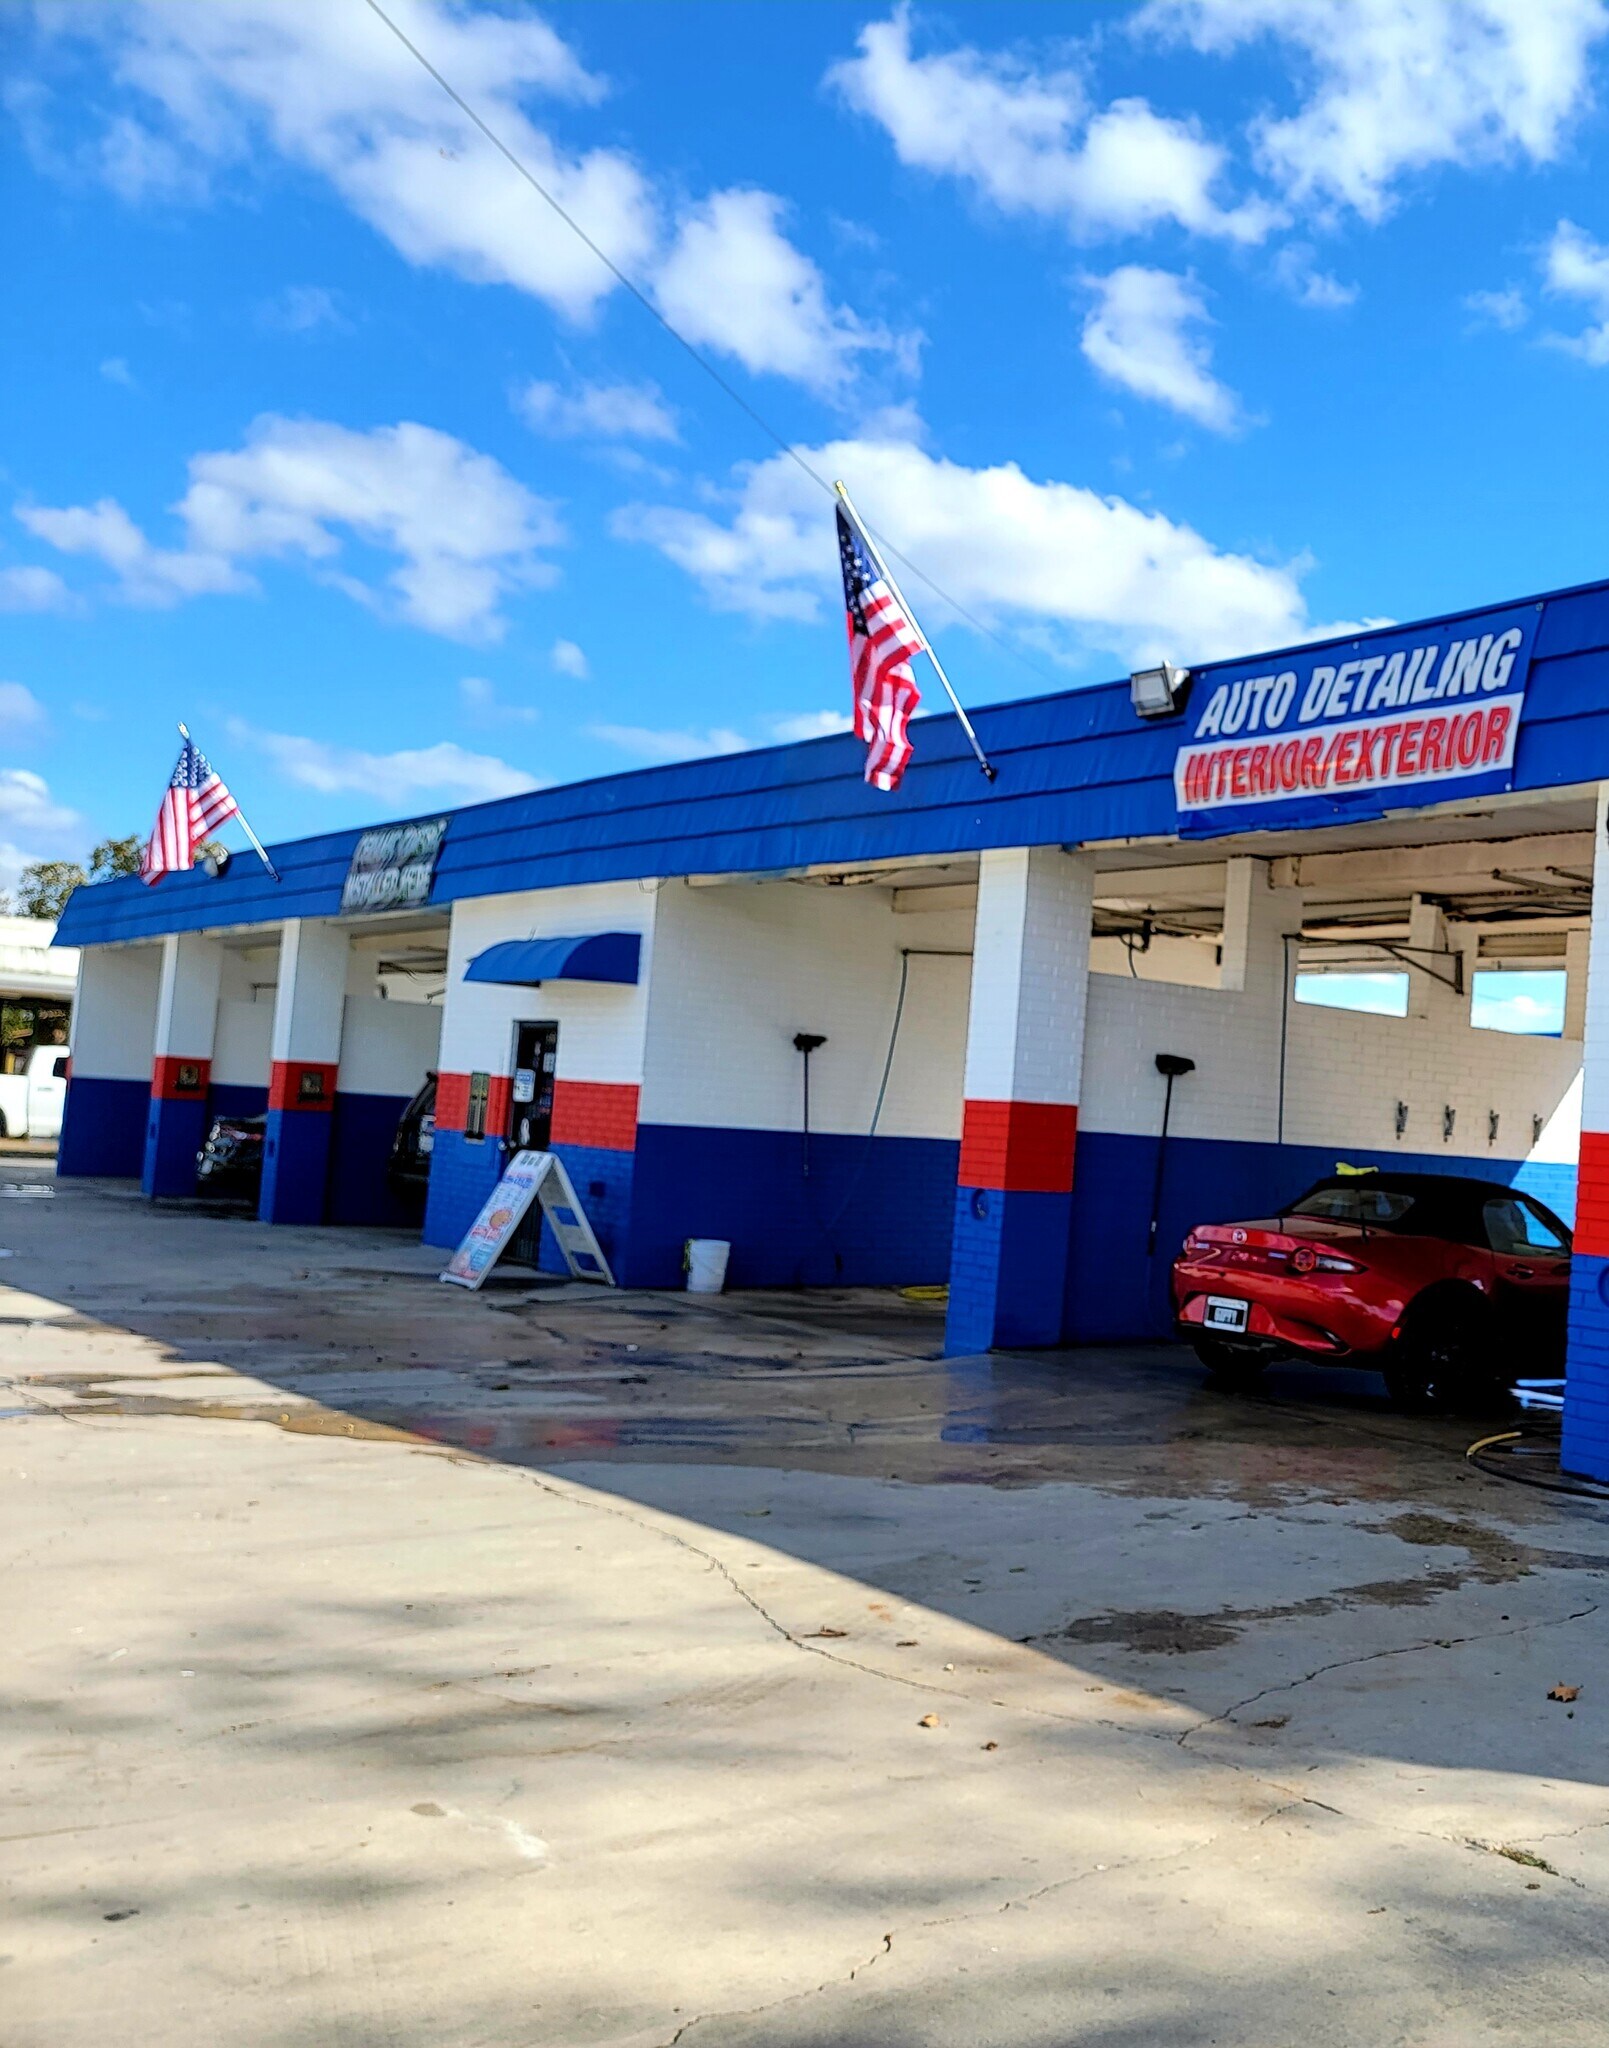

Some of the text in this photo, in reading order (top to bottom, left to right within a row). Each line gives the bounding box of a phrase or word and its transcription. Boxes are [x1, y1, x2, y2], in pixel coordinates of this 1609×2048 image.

[1194, 628, 1523, 738] AUTO DETAILING
[1184, 706, 1511, 804] INTERIOR/EXTERIOR
